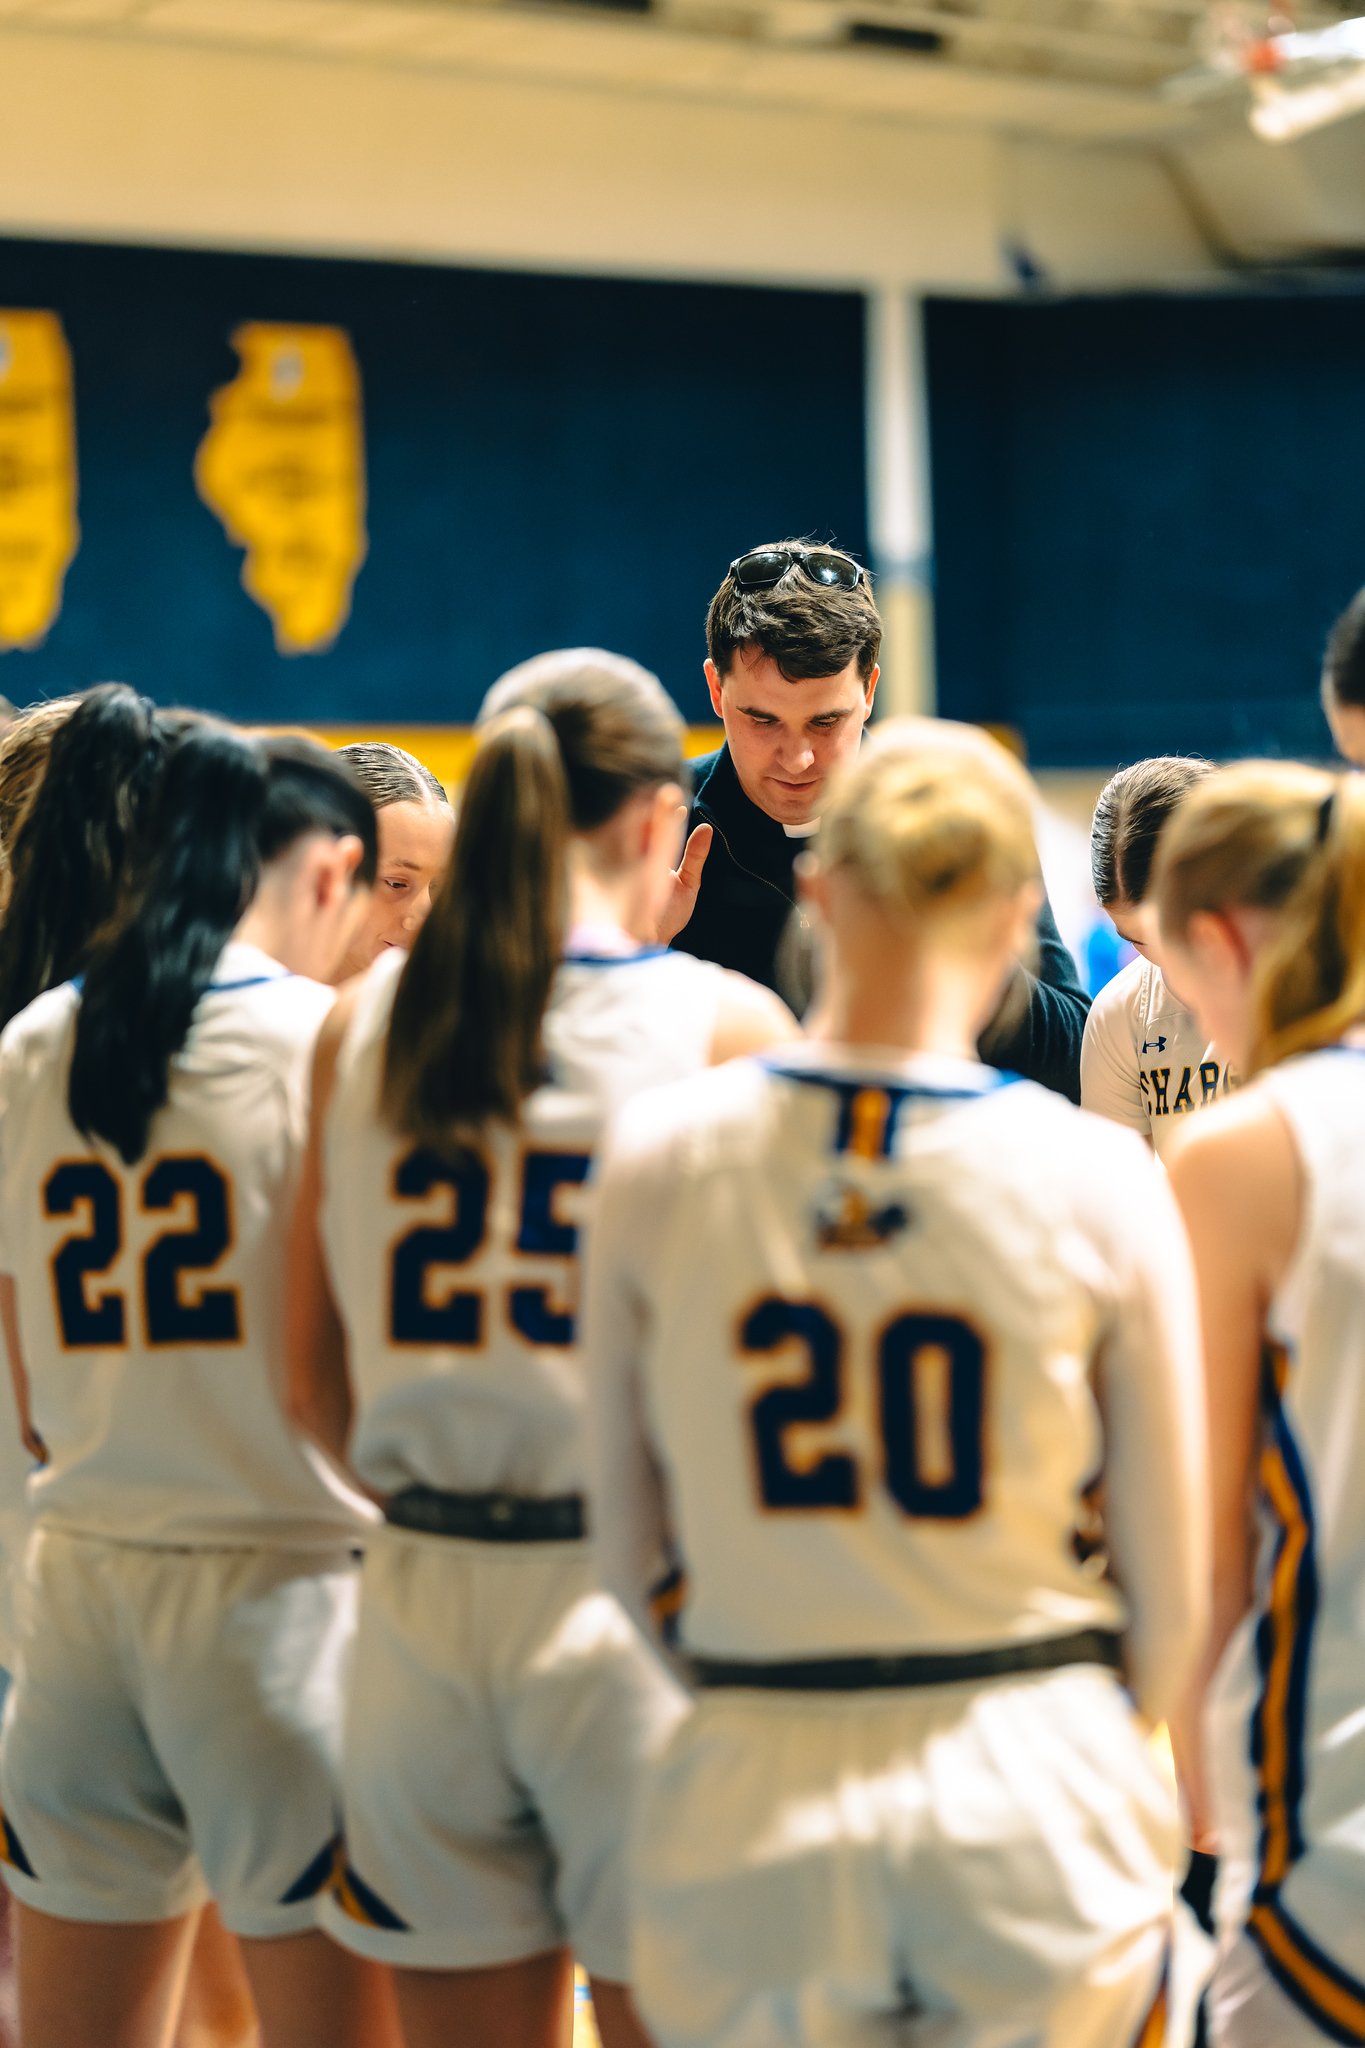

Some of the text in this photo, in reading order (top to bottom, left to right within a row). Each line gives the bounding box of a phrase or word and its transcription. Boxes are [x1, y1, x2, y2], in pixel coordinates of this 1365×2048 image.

[41, 1152, 244, 1350] 22
[388, 1140, 592, 1350] 25
[738, 1293, 989, 1522] 20
